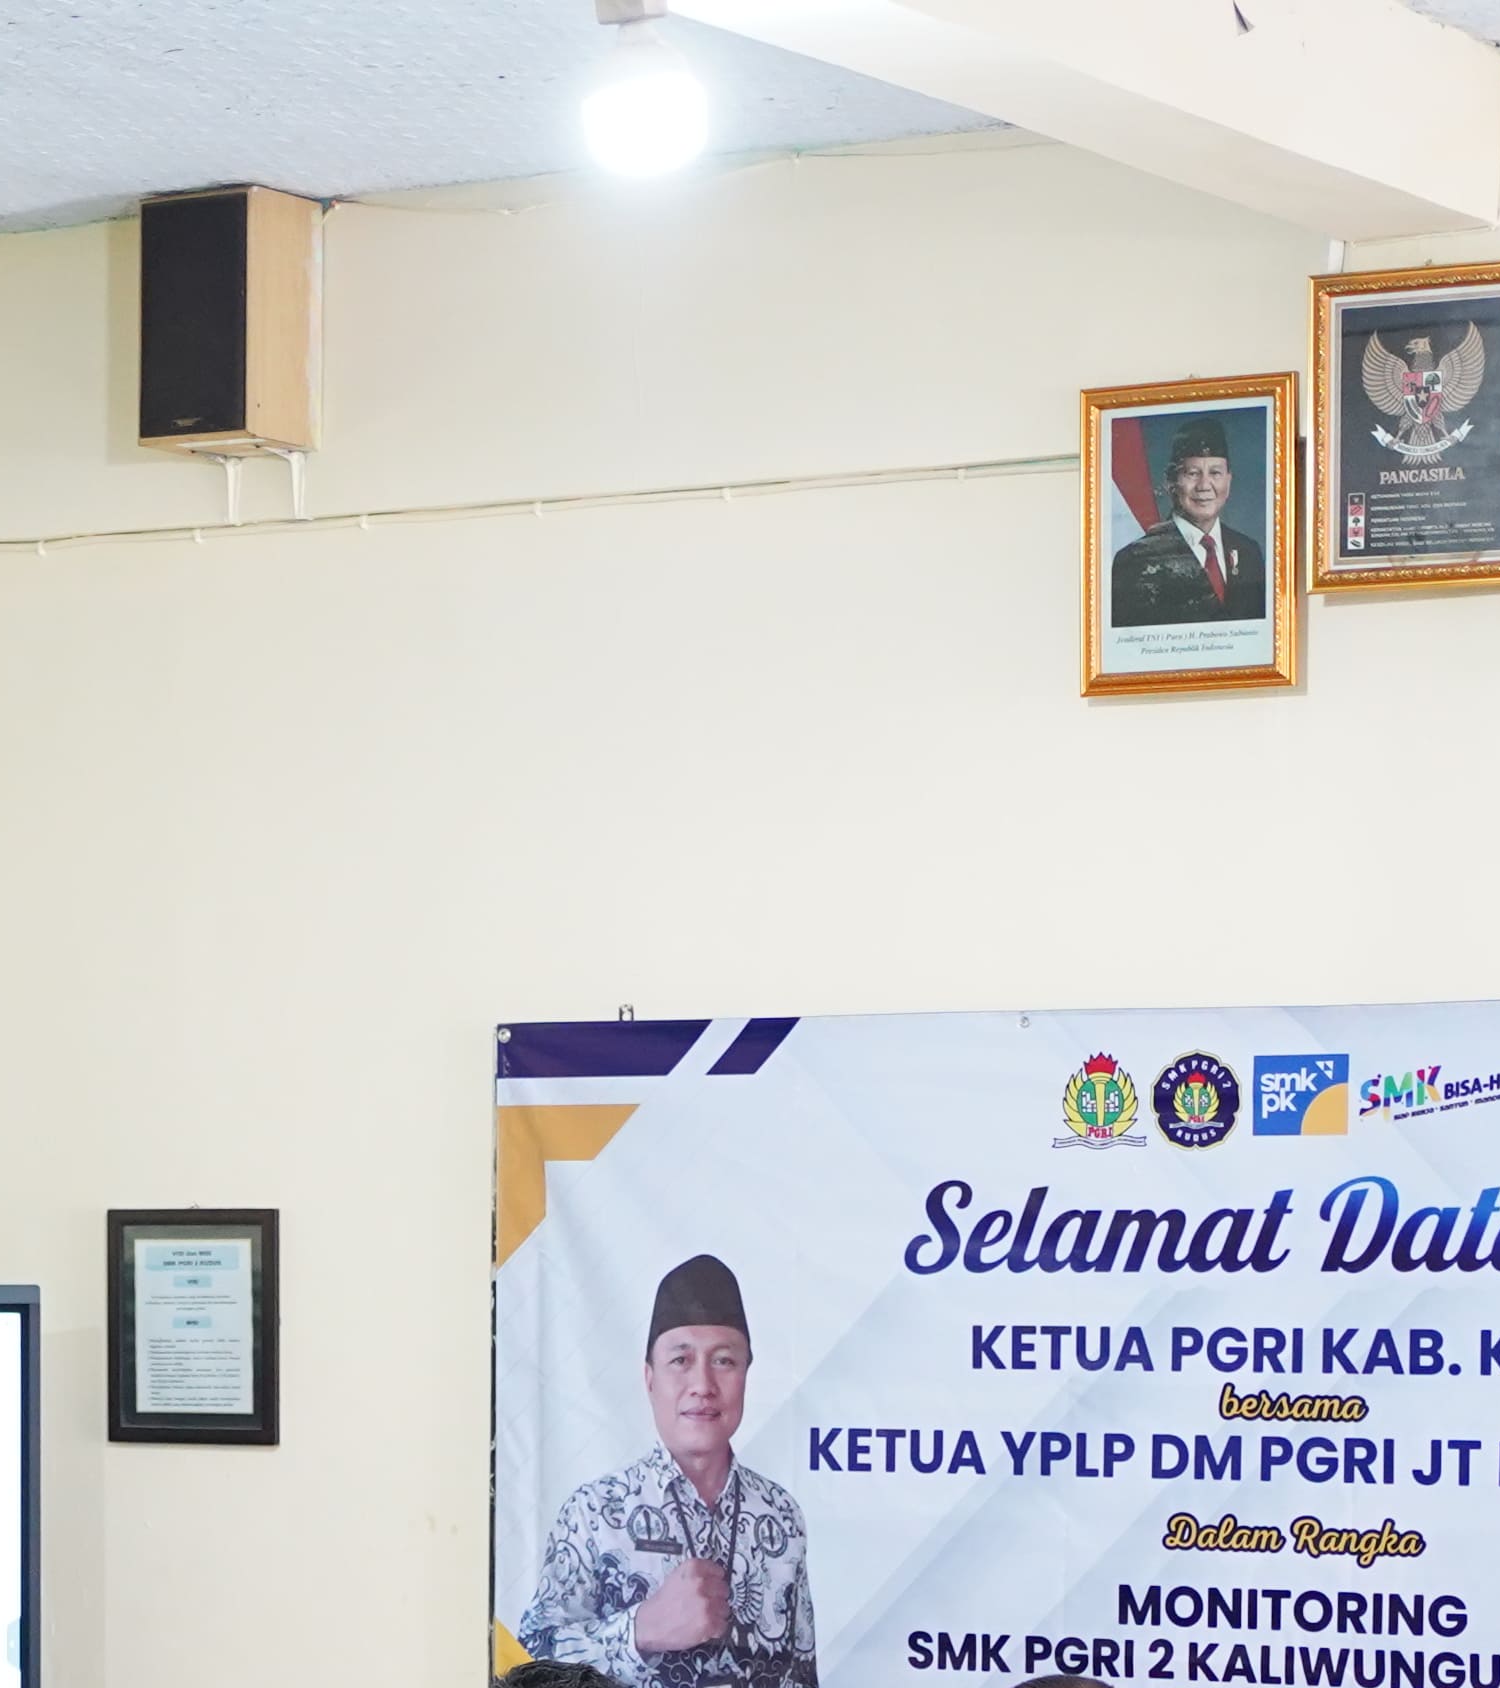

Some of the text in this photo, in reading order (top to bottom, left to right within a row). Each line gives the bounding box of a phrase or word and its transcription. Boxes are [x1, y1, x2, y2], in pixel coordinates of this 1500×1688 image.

[1379, 466, 1466, 485] PANCASILA
[1161, 1063, 1188, 1090] SMK
[1191, 1059, 1225, 1080] PGRI
[1260, 1067, 1317, 1092] smk
[1358, 1065, 1442, 1119] SMK
[1261, 1090, 1297, 1119] pk
[1087, 1126, 1113, 1139] PGRI
[904, 1180, 1295, 1275] Selamat
[971, 1325, 1155, 1372] KETUA
[1170, 1327, 1303, 1374] PGRI
[1322, 1328, 1462, 1376] KAB.
[1218, 1382, 1368, 1423] bersama
[809, 1427, 986, 1475] KETUA
[1000, 1430, 1136, 1478] YPLP
[1151, 1433, 1243, 1481] DM
[1260, 1435, 1396, 1485] PGRI
[1411, 1439, 1482, 1487] JT
[1161, 1511, 1426, 1568] Dalam Rangka
[1118, 1584, 1468, 1637] MONITORING
[907, 1630, 1011, 1673] SMK
[1024, 1635, 1134, 1678] PGRI
[1148, 1638, 1175, 1680] 2
